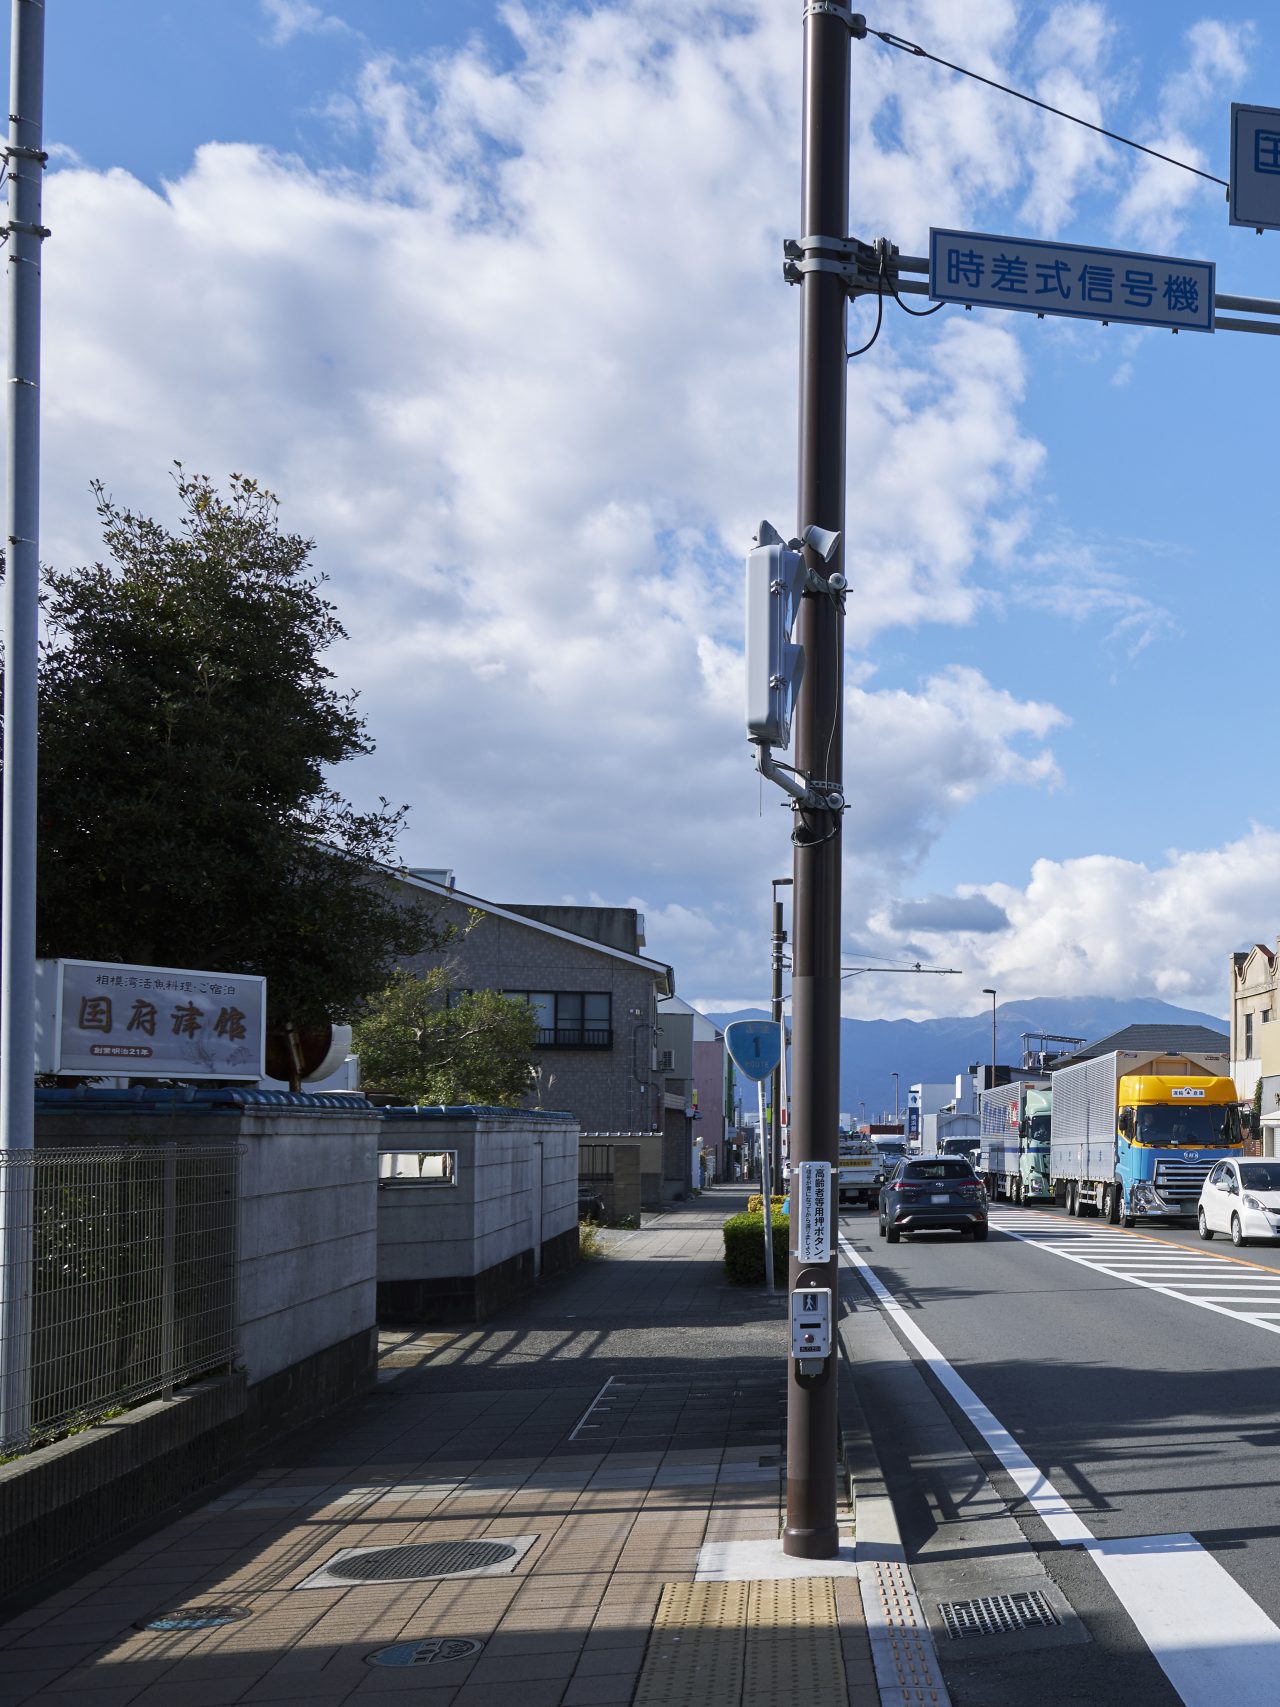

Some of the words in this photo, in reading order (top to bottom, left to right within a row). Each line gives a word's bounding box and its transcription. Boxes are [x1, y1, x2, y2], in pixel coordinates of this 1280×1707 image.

[946, 246, 1201, 316] 時差式信号機
[79, 996, 248, 1041] 国府津館
[752, 1035, 760, 1058] 1
[814, 1168, 825, 1257] 高齢者等用押ボタン
